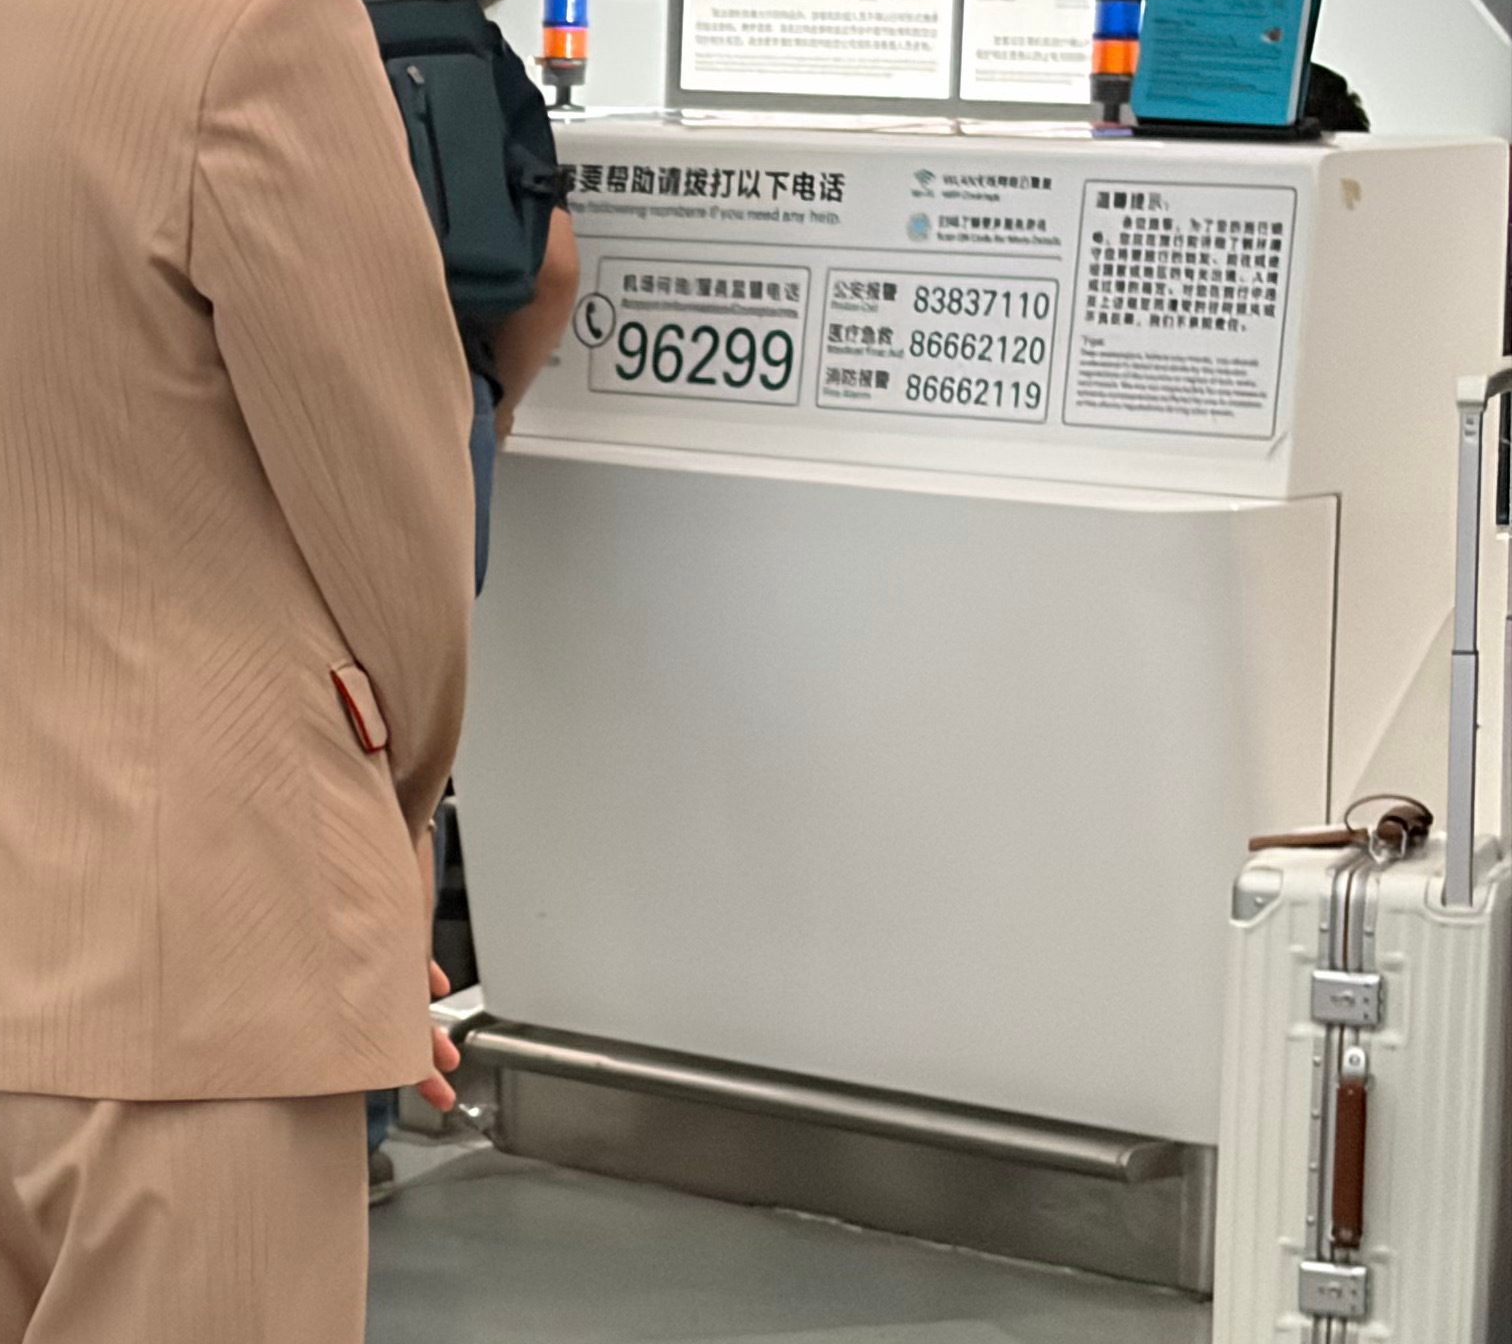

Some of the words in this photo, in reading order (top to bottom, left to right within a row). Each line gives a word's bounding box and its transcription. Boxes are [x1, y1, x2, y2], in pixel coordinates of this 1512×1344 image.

[747, 207, 779, 222] need
[782, 213, 805, 225] any
[913, 285, 1050, 320] 83837110
[615, 321, 794, 391] 96299
[909, 329, 1045, 365] 86662120
[905, 373, 1041, 409] 86662119
